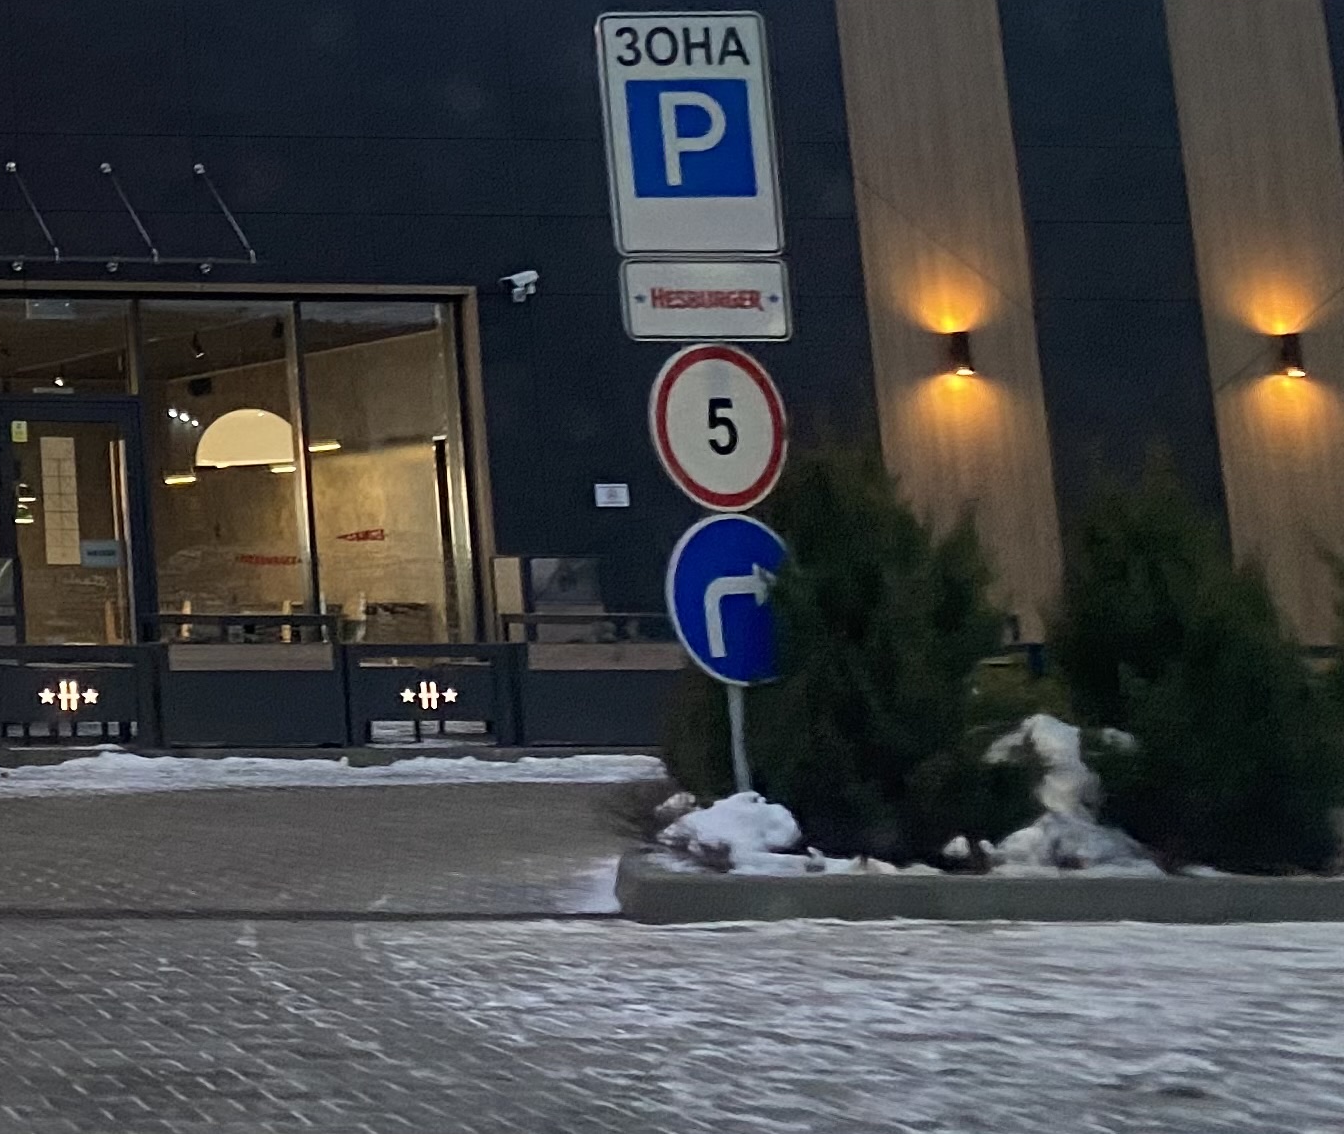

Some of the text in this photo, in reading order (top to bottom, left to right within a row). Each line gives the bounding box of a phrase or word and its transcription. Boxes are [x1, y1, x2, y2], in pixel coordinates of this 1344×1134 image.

[615, 26, 751, 67] ЗОНА
[659, 91, 726, 186] P
[651, 287, 765, 311] HESBURGER
[708, 398, 739, 455] 5
